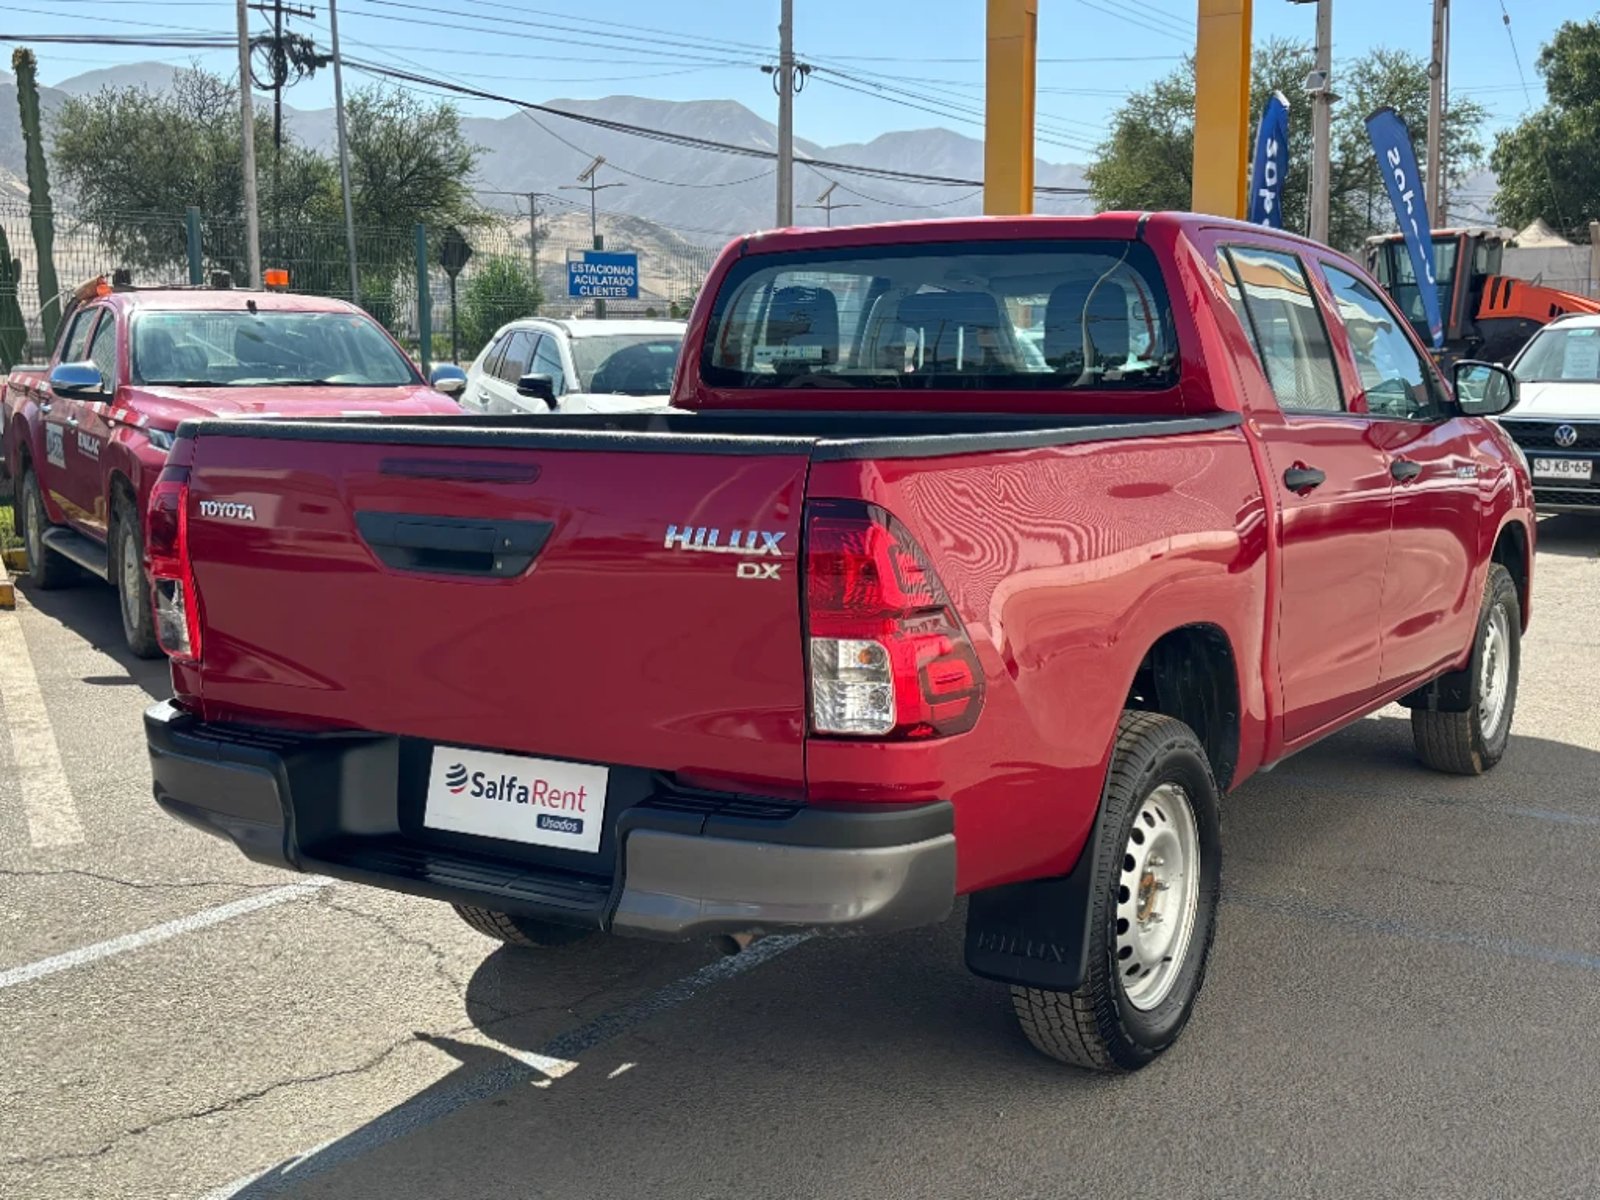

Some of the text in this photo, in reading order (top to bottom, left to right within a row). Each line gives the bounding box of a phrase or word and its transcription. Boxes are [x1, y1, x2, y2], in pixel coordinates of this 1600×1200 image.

[571, 262, 635, 276] ESTACIONAR
[574, 274, 635, 287] ACULATADO
[579, 285, 629, 296] CLIENTES
[199, 500, 256, 521] TOYOTA
[664, 525, 786, 556] HILUX
[736, 562, 782, 580] DX
[541, 816, 578, 832] Usados
